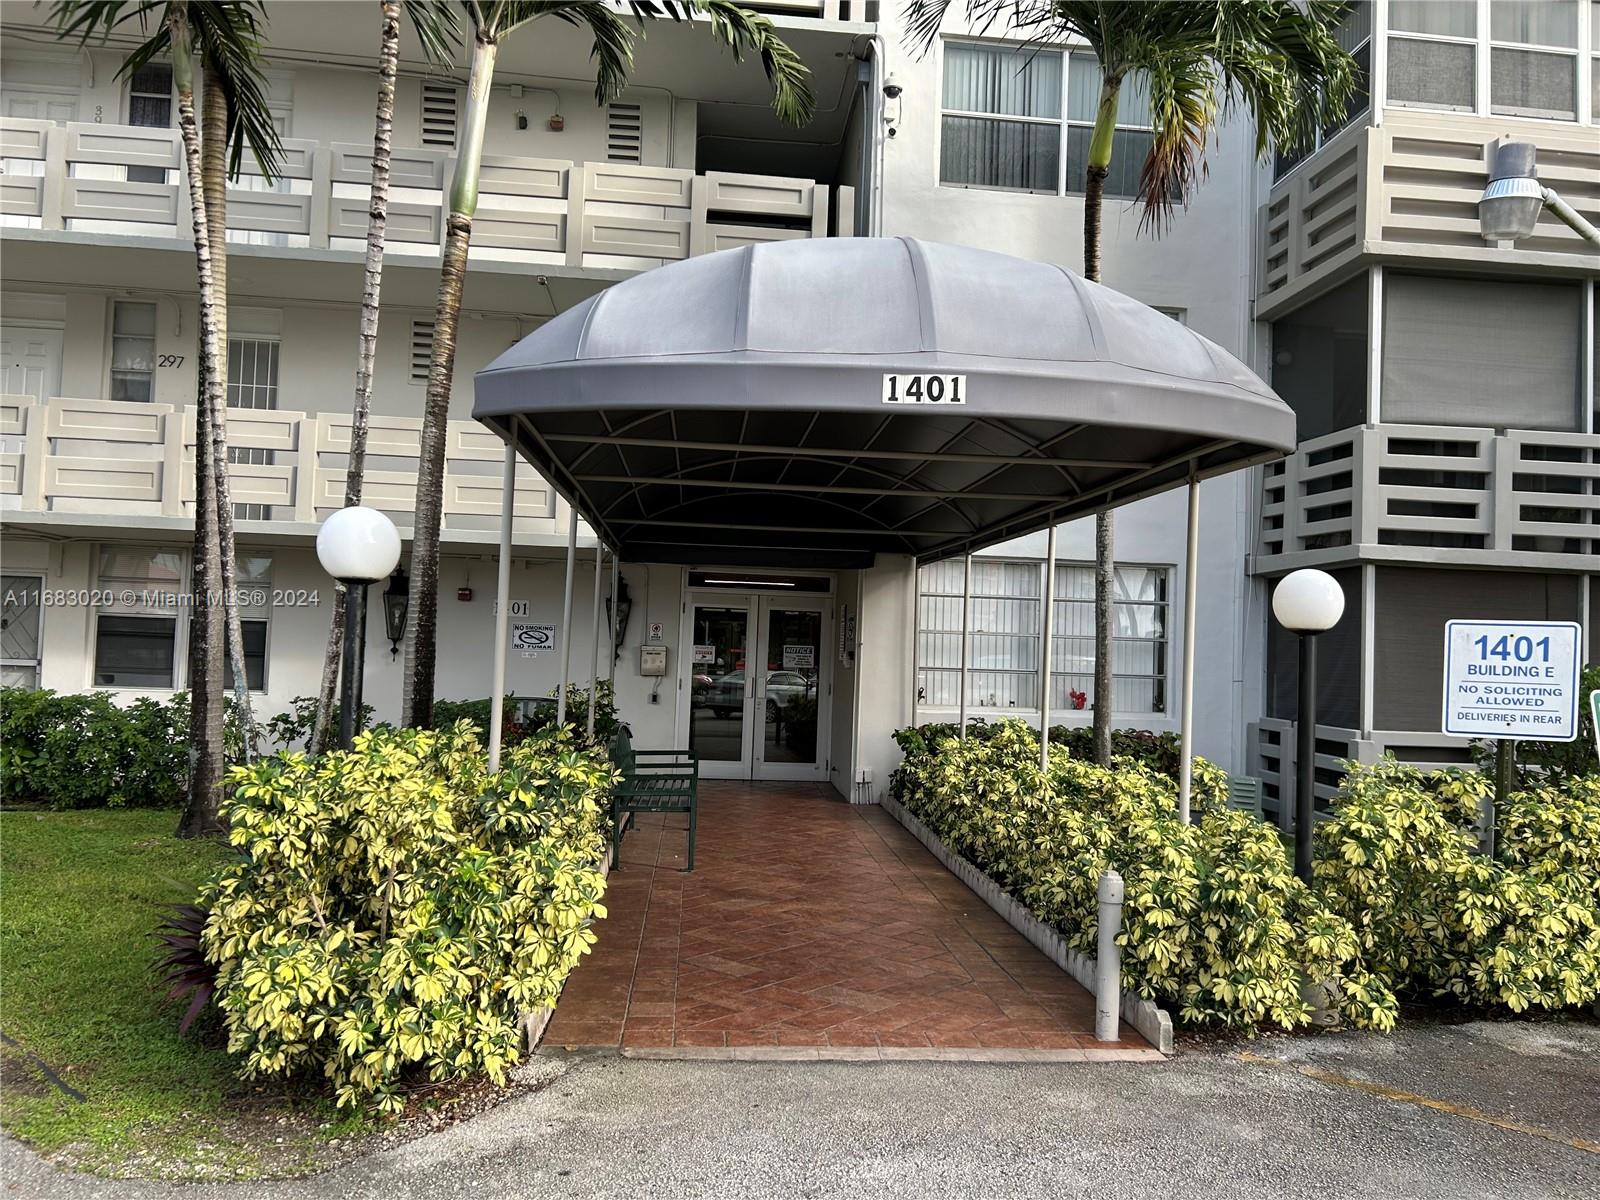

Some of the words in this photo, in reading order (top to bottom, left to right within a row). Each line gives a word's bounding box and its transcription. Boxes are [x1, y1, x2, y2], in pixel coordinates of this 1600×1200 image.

[158, 354, 185, 369] 297
[887, 375, 961, 403] 1401
[1474, 635, 1550, 662] 1401
[1467, 664, 1540, 678] BUILDING
[1545, 666, 1555, 678] E
[1458, 685, 1479, 694] NO
[1483, 686, 1563, 697] SOLICITING
[1475, 697, 1545, 707] ALLOWED
[1457, 712, 1517, 722] DELIVERIES
[1519, 714, 1530, 723] IN
[1533, 715, 1562, 725] REAR
